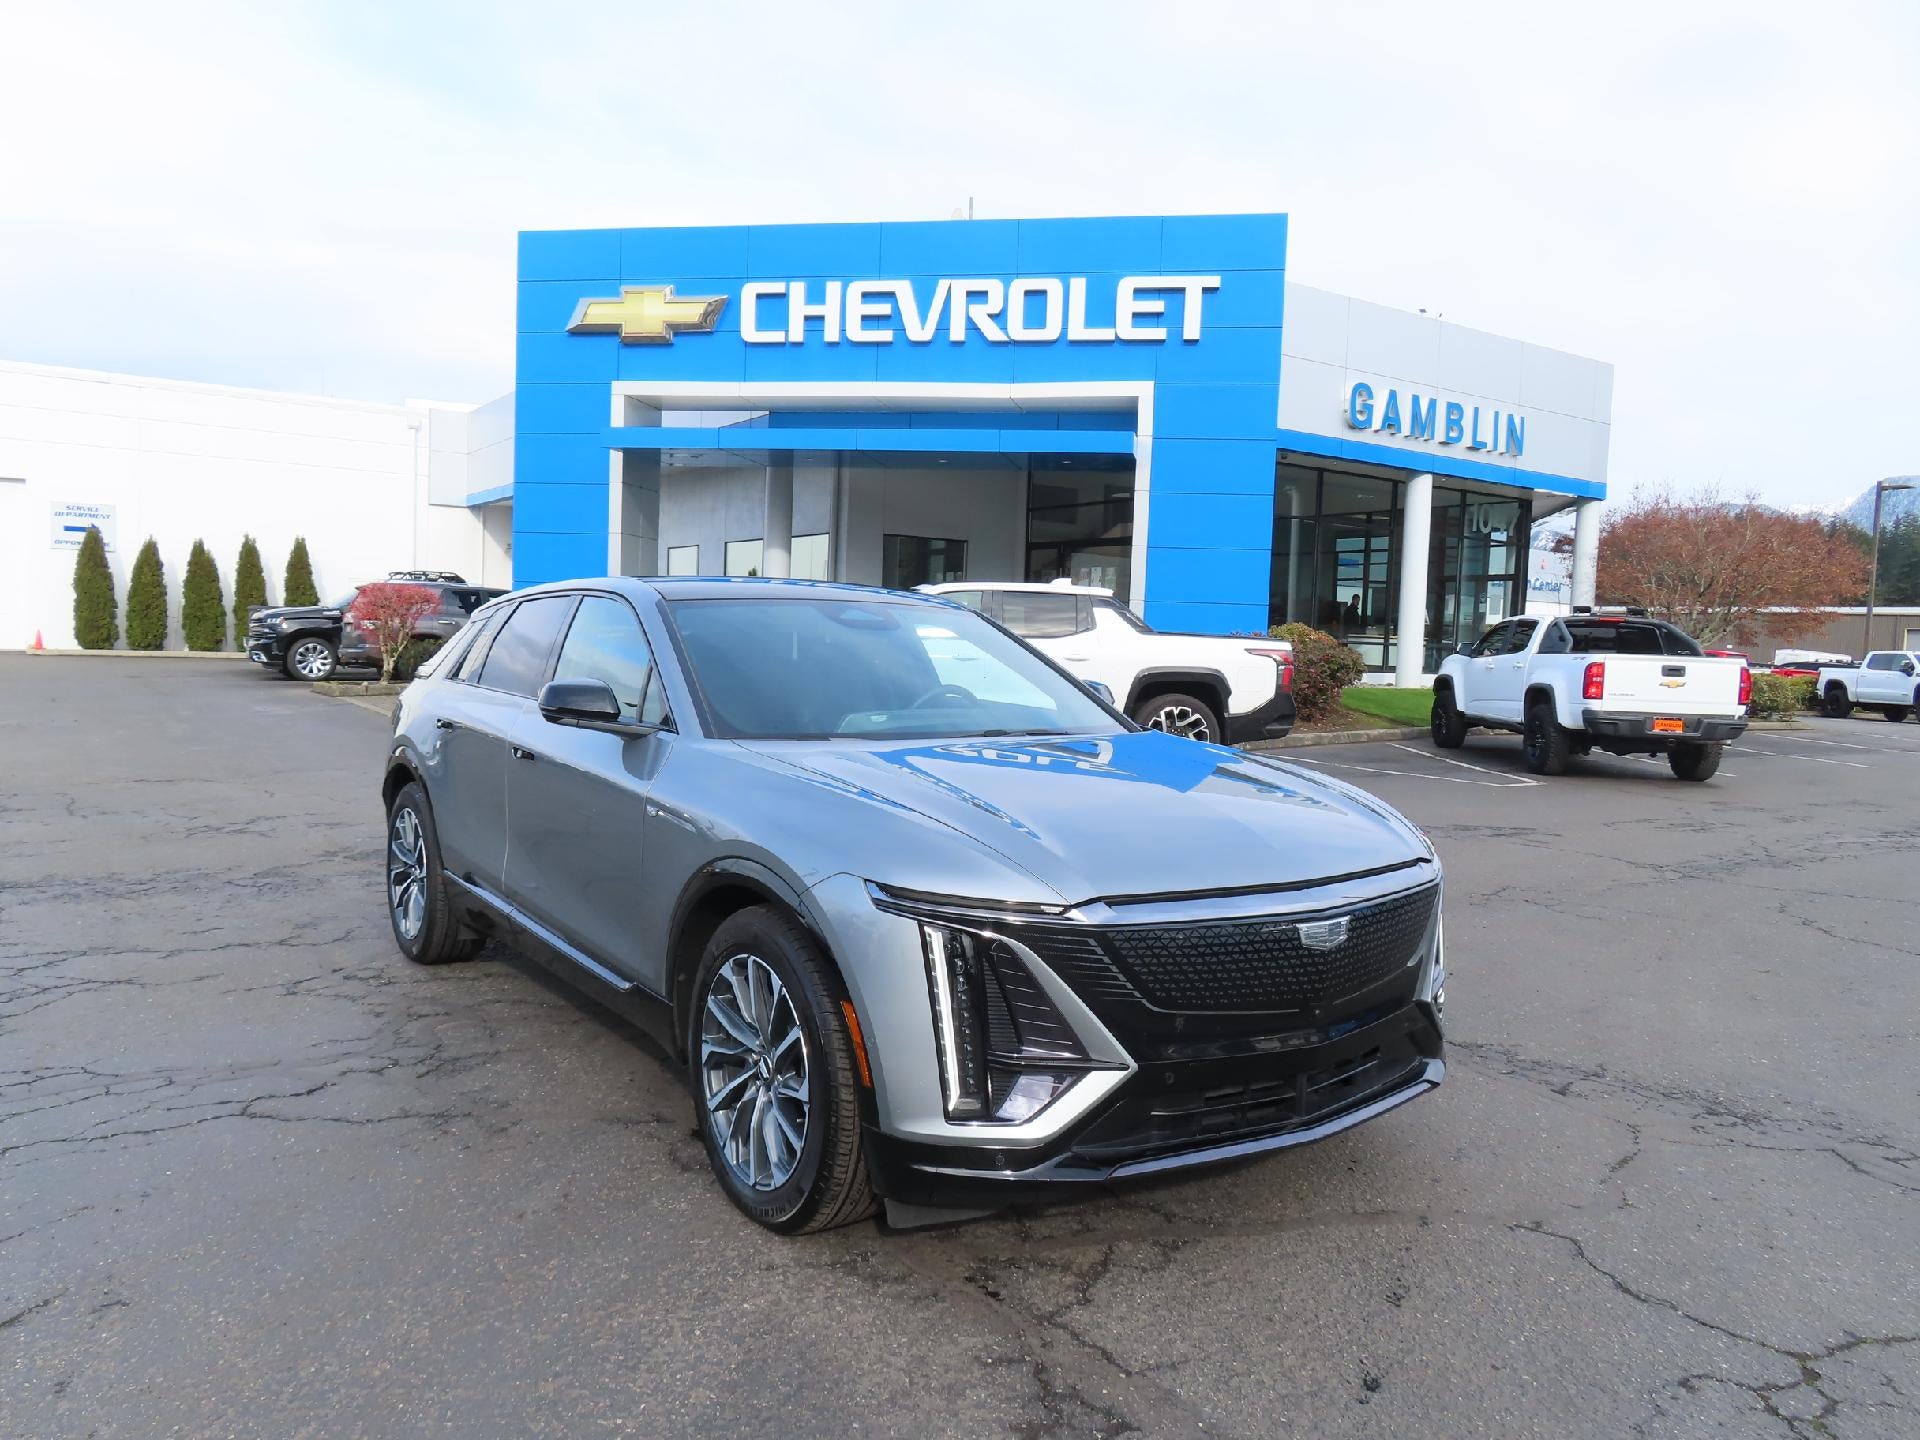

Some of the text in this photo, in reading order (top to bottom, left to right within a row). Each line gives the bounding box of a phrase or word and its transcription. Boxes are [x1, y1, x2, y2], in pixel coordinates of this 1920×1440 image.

[740, 275, 1222, 344] CHEVROLET
[1350, 382, 1525, 456] GAMBLIN
[54, 511, 111, 520] DEPARTMENT
[65, 504, 99, 512] SERVICE
